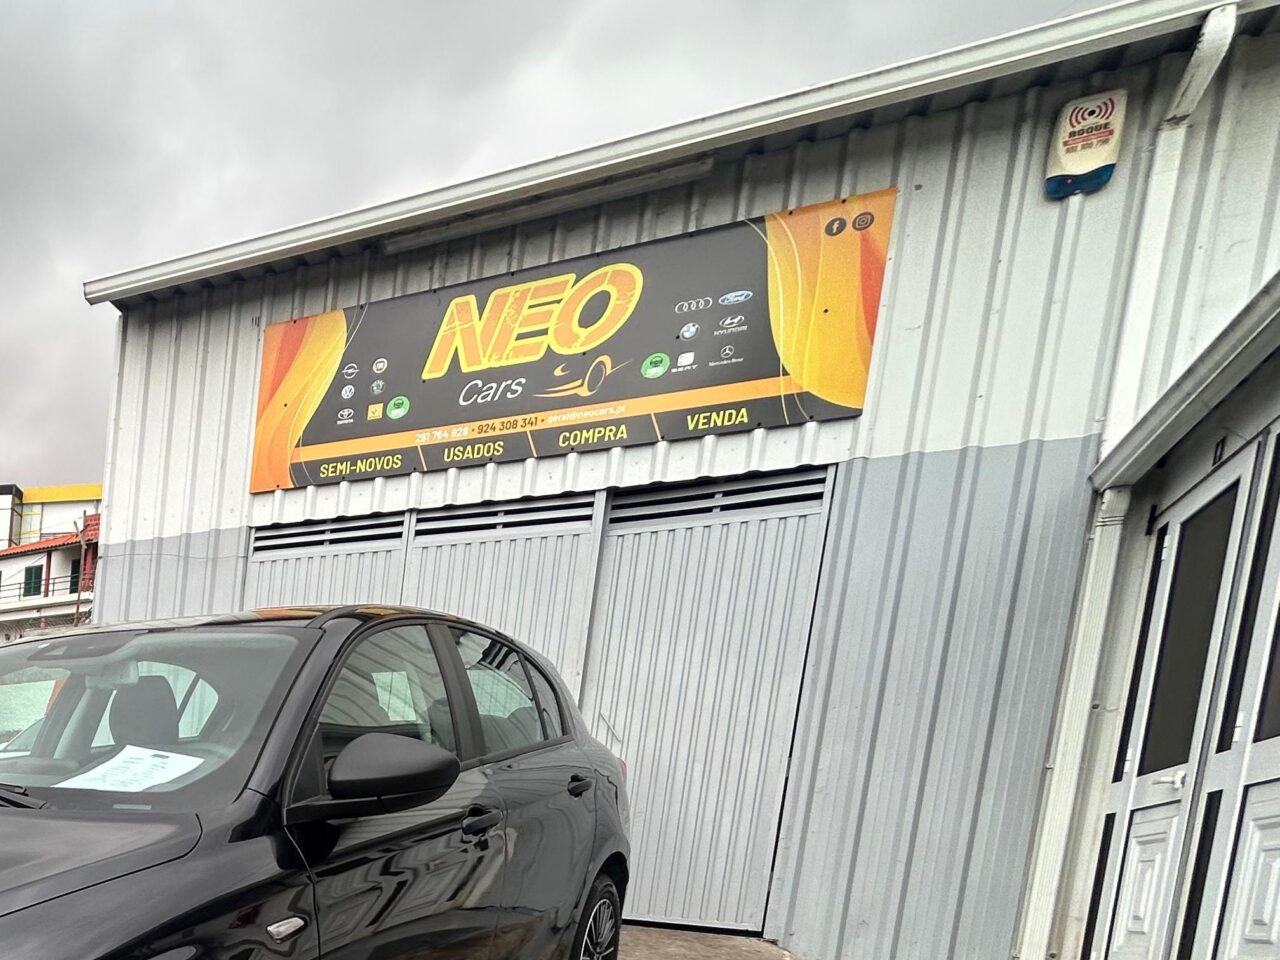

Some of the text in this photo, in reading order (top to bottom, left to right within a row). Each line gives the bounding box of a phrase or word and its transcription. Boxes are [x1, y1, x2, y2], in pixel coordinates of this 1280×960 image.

[421, 263, 643, 380] NEO
[458, 377, 526, 406] Cars
[477, 422, 496, 434] 924
[498, 419, 518, 431] 308
[520, 416, 538, 428] 341
[687, 407, 749, 431] VENDA
[558, 424, 628, 448] COMPRA
[443, 441, 504, 462] USADOS
[319, 454, 402, 478] SEMI-NOVOS
